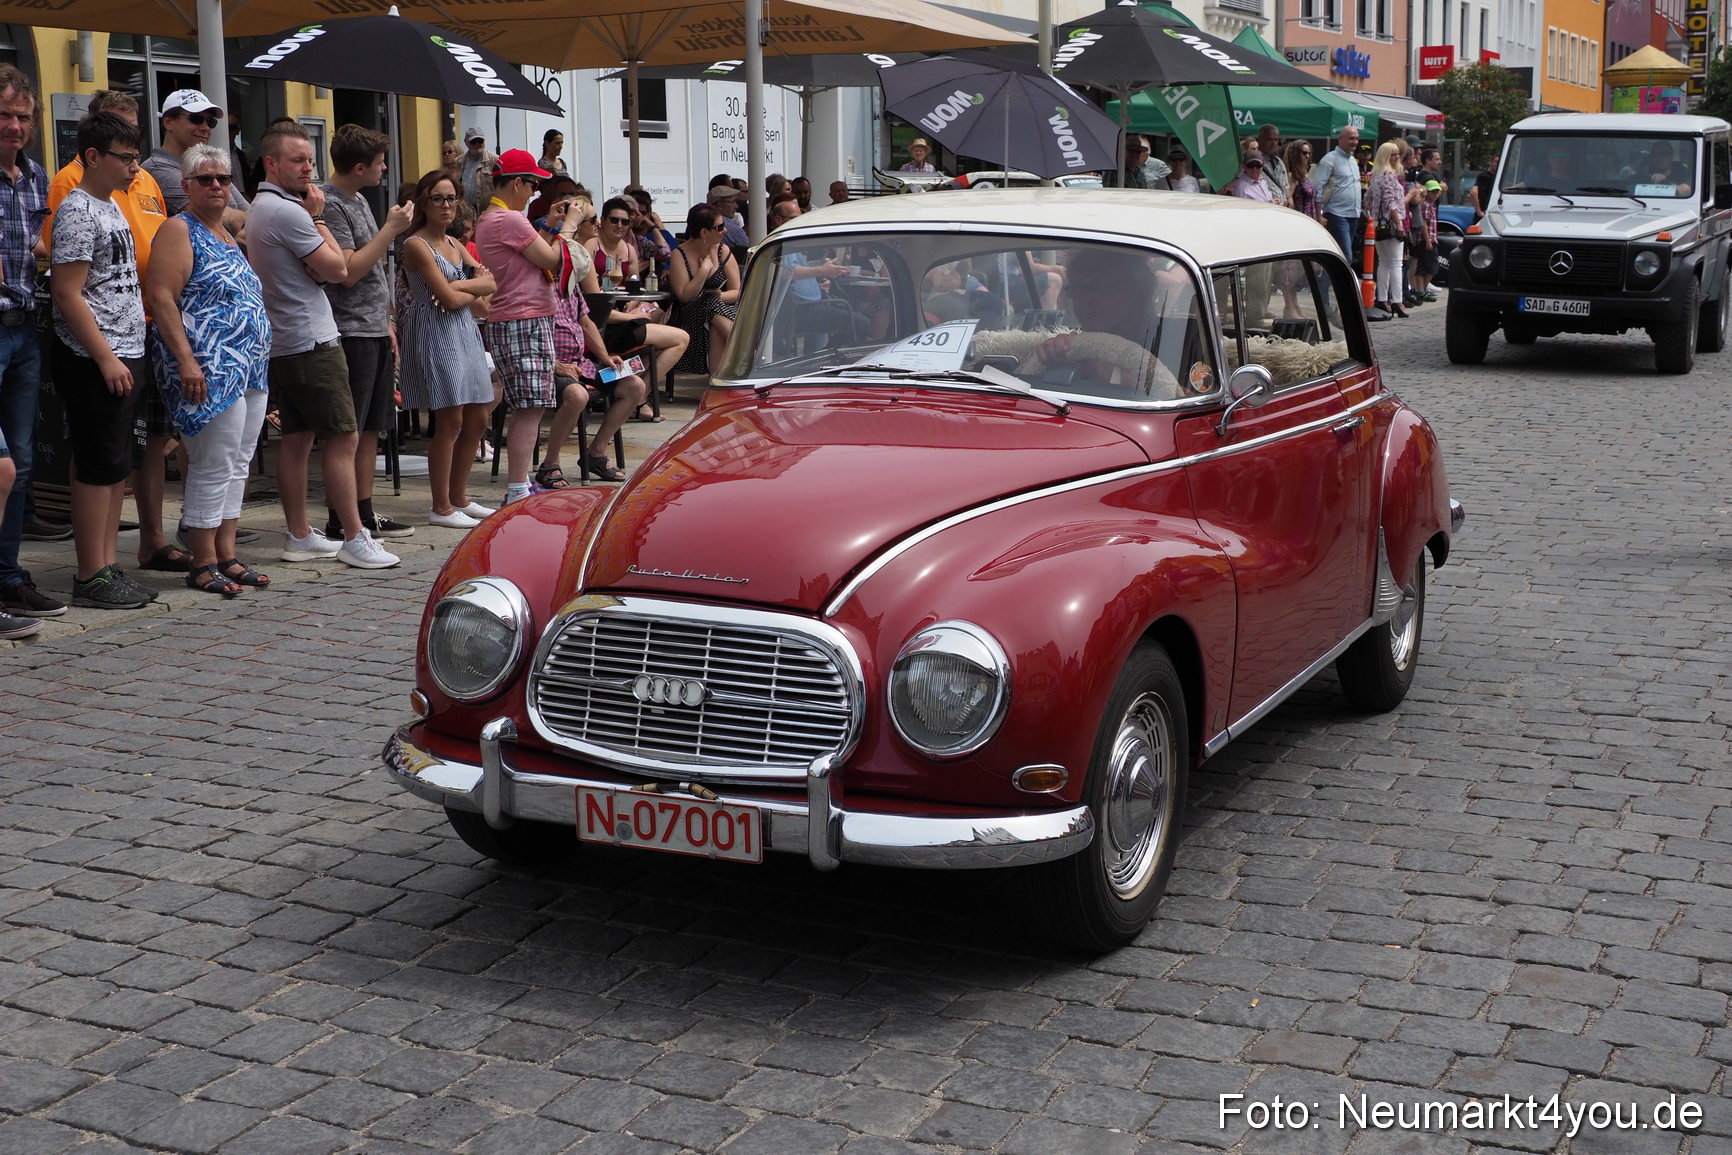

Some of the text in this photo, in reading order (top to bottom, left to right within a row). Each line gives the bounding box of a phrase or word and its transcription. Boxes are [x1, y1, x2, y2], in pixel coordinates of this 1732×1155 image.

[1424, 57, 1447, 66] WITT
[725, 96, 740, 117] 30
[711, 122, 736, 144] Bang
[738, 124, 745, 141] &
[720, 146, 728, 162] in
[663, 186, 685, 194] Fernseher
[1525, 299, 1589, 314] SAD G 460H
[908, 331, 950, 346] 430
[585, 793, 751, 854] N-07001
